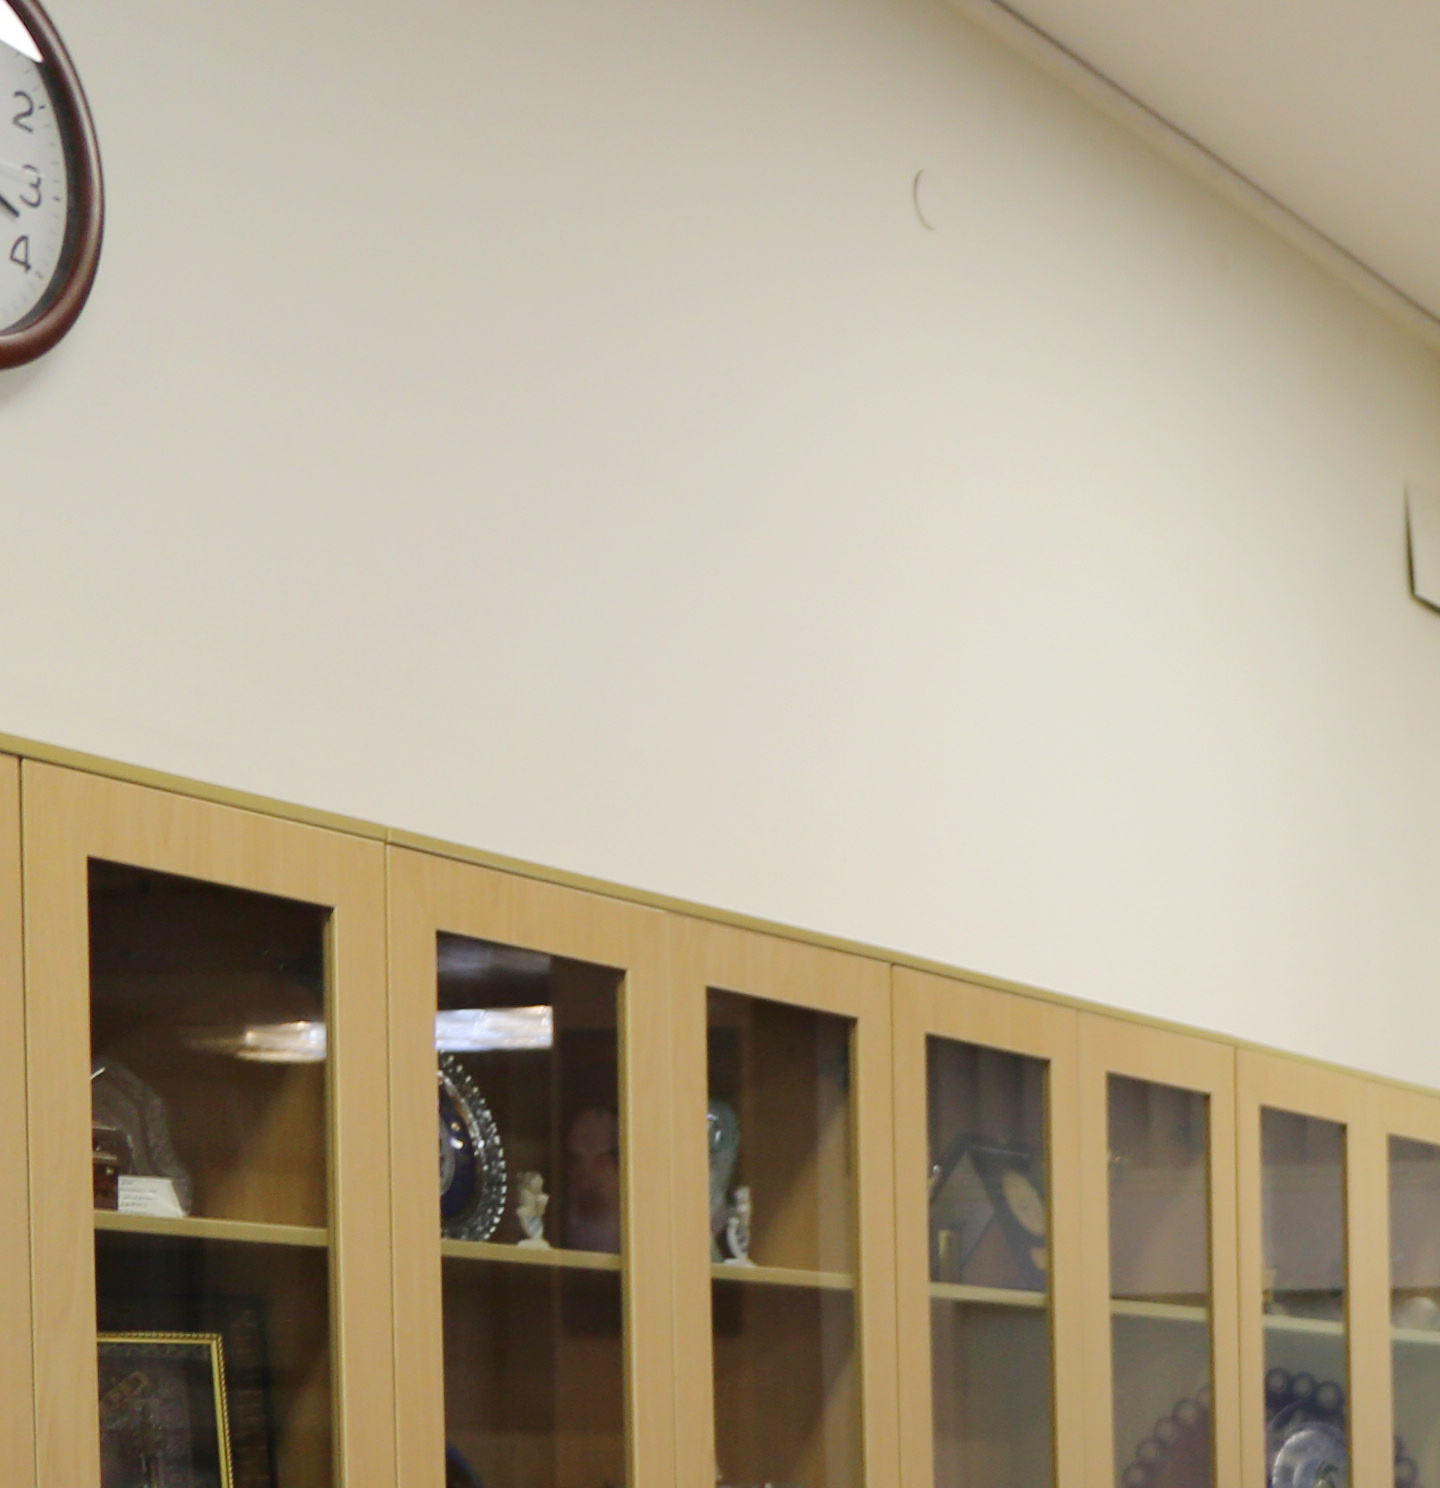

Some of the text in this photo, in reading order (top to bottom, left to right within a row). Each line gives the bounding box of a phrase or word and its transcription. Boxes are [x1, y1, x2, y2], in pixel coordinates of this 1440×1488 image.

[12, 90, 35, 133] 2
[19, 163, 43, 209] 3
[9, 235, 32, 273] 4
